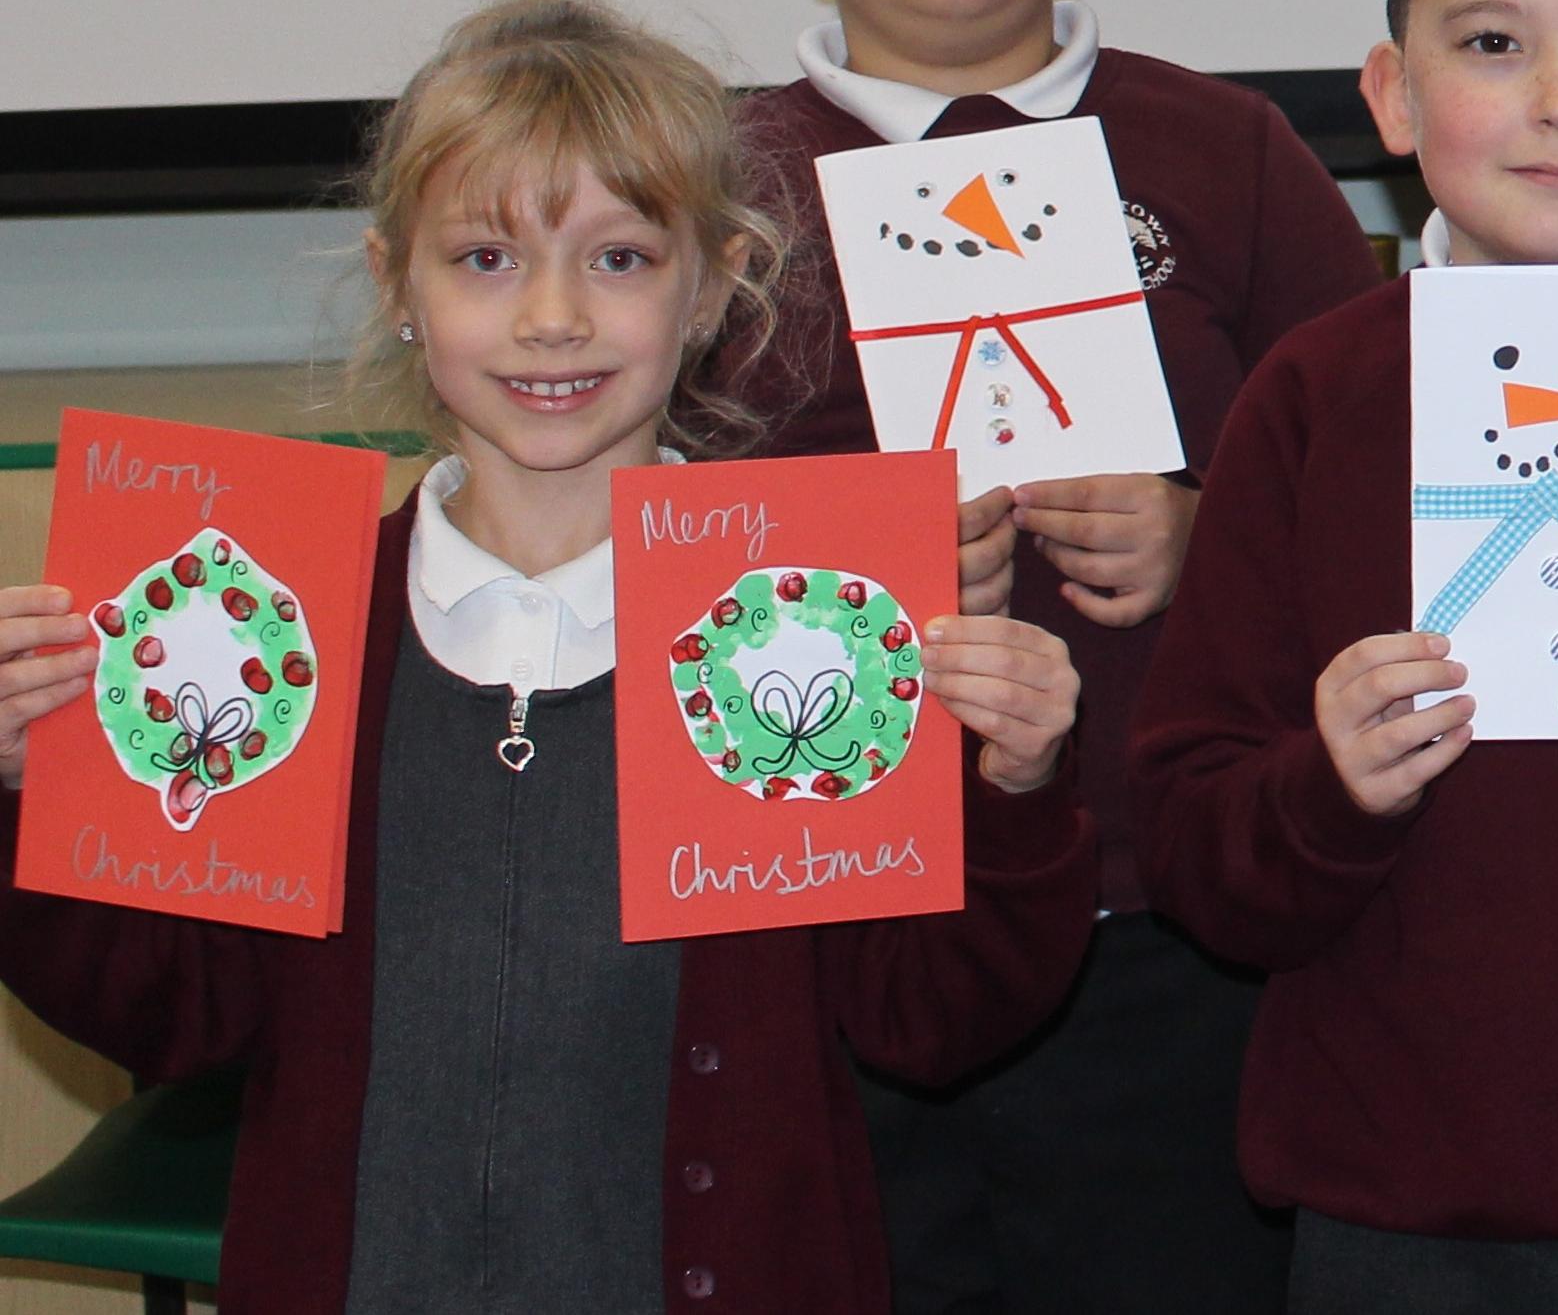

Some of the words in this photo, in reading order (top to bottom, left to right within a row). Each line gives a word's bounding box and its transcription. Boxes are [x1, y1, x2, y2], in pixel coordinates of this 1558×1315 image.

[85, 440, 231, 521] Merry
[640, 498, 779, 562] Merry
[71, 824, 316, 908] Christmas
[668, 826, 925, 899] Christmas
